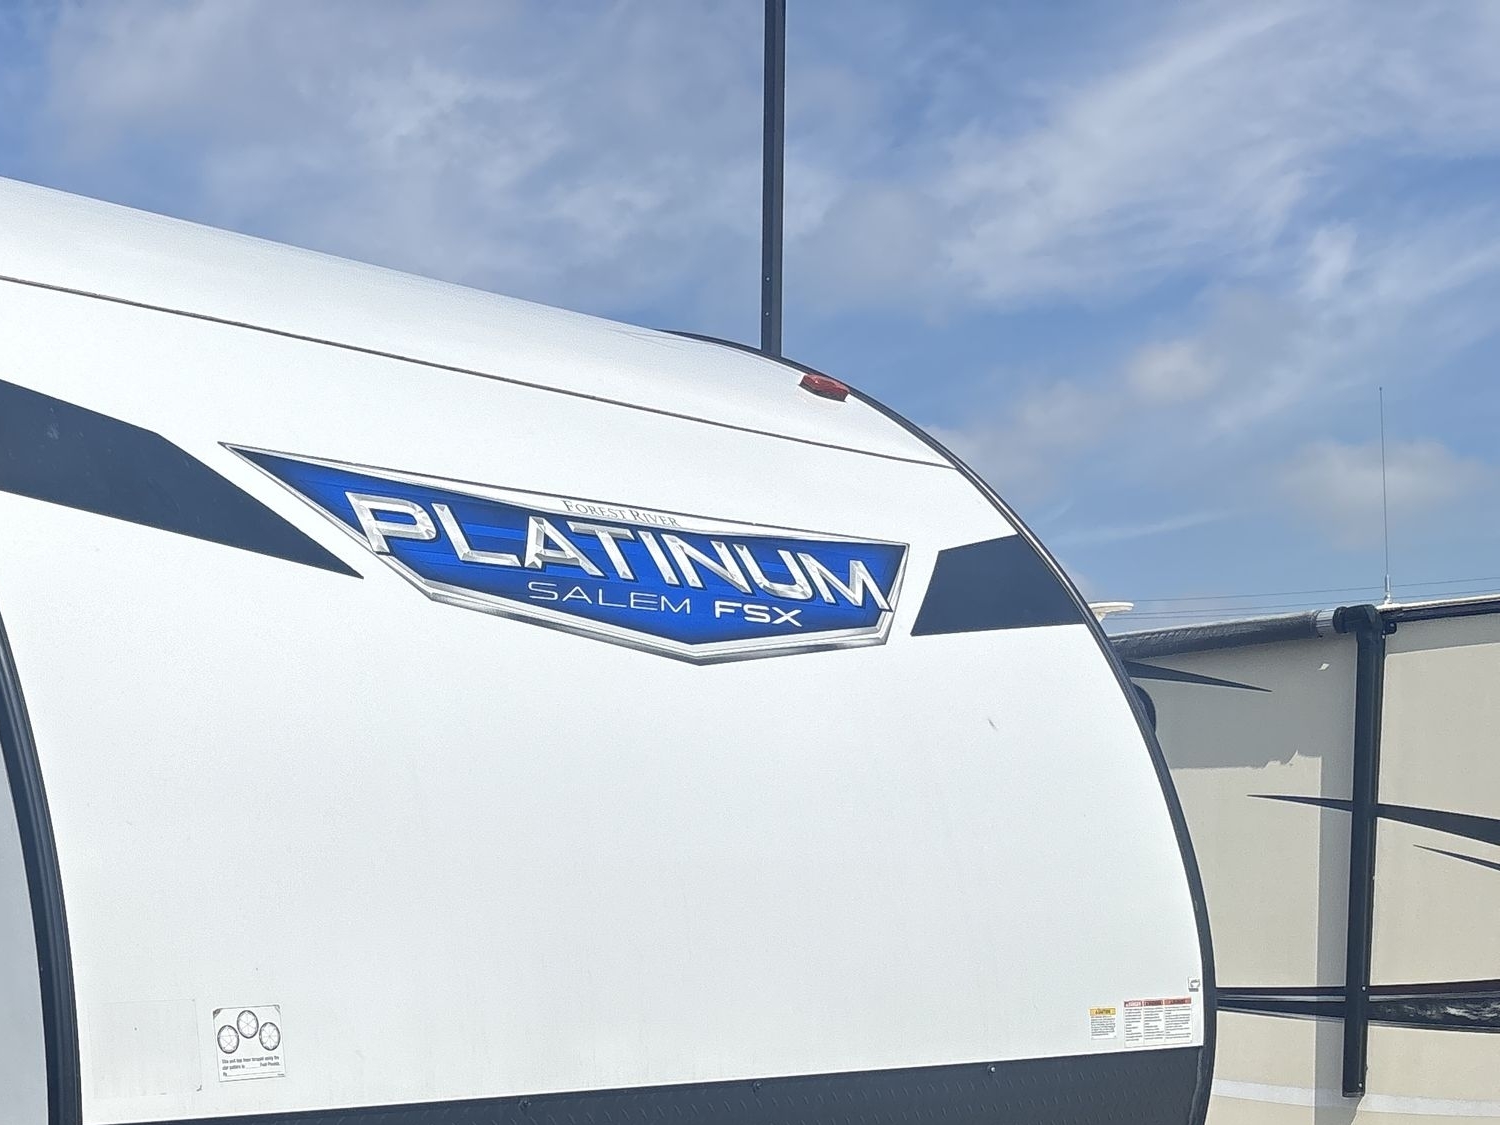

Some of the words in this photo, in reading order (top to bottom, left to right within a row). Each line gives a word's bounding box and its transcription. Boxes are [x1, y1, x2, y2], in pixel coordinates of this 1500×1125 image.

[561, 499, 627, 519] FOREST
[628, 509, 681, 527] RIVER
[343, 490, 892, 612] PLATINUM
[527, 580, 691, 614] SALEM
[713, 599, 802, 628] FSX
